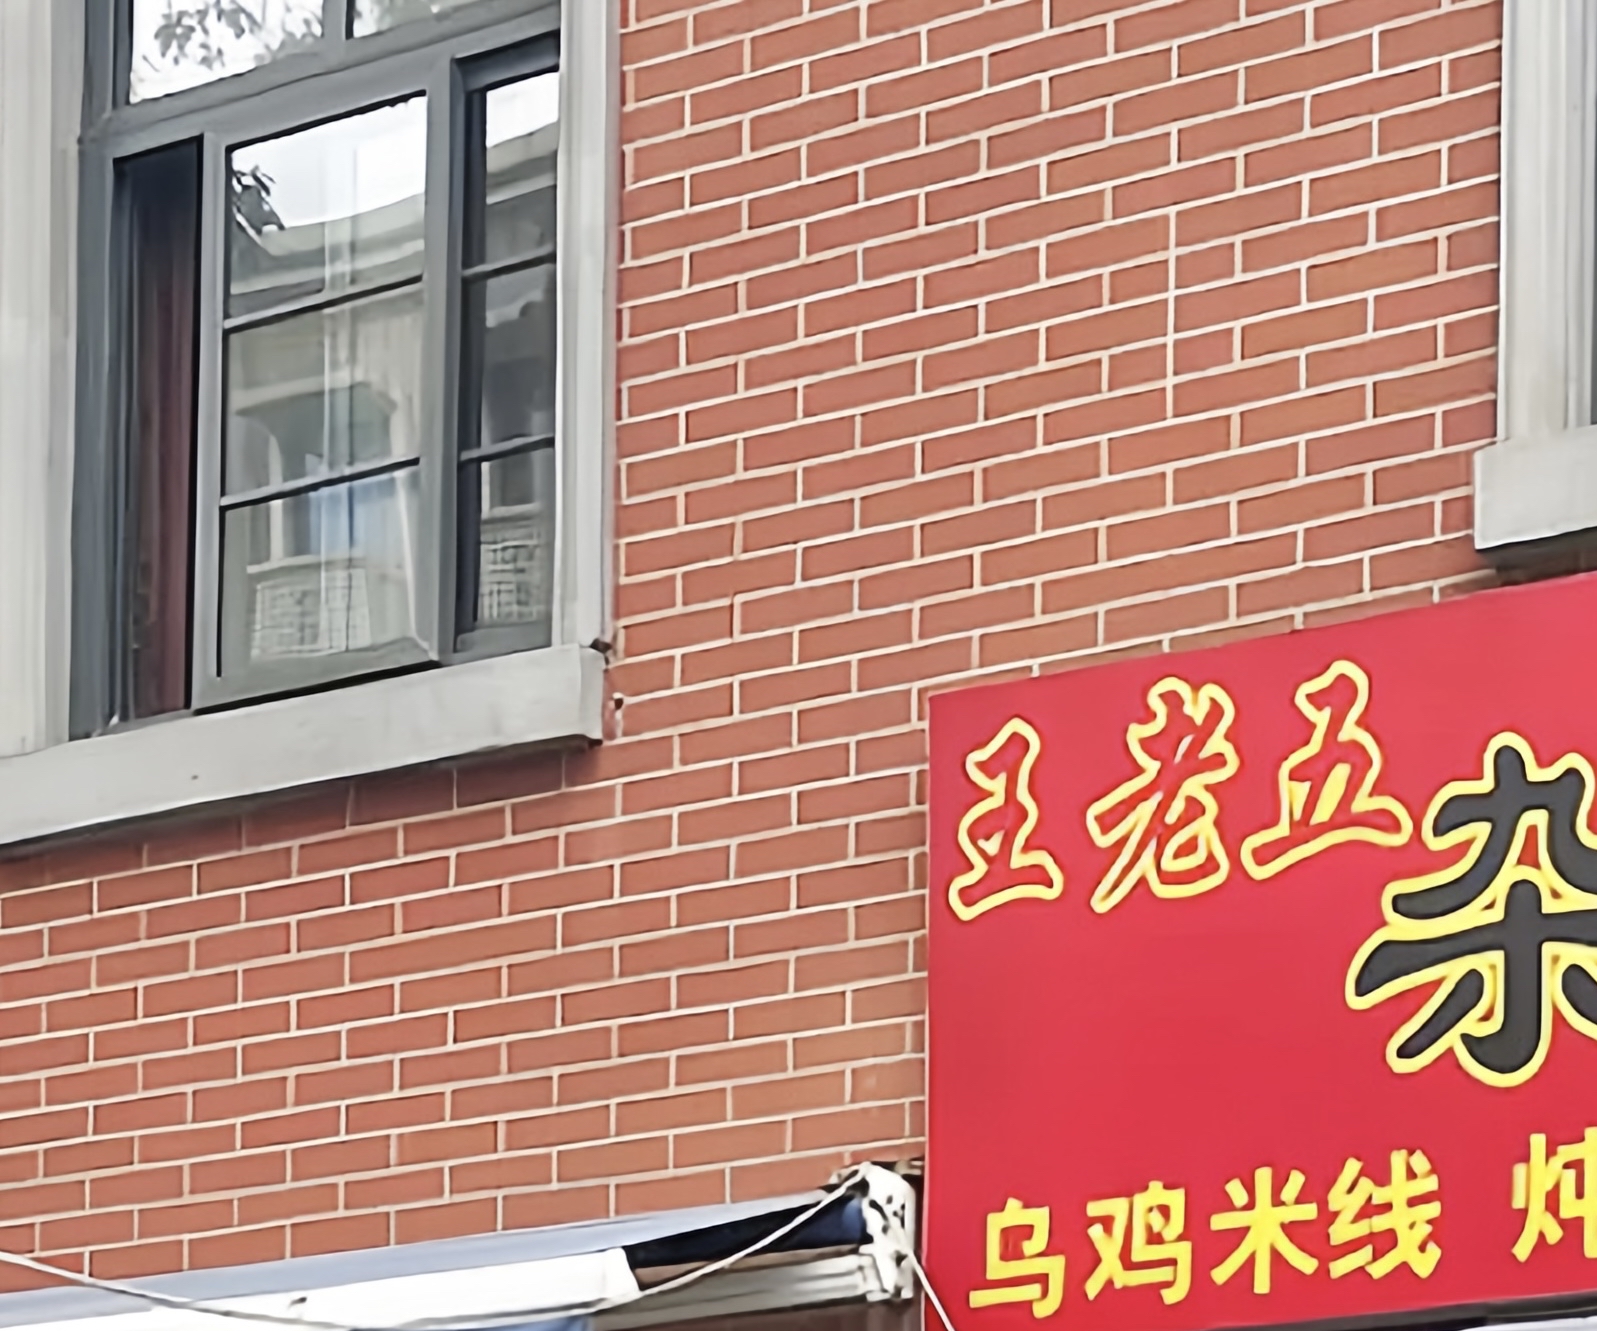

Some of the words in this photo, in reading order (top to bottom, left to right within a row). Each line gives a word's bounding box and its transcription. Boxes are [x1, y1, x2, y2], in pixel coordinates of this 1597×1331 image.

[948, 660, 1411, 921] 王老五
[968, 1150, 1442, 1319] 乌鸡米线
